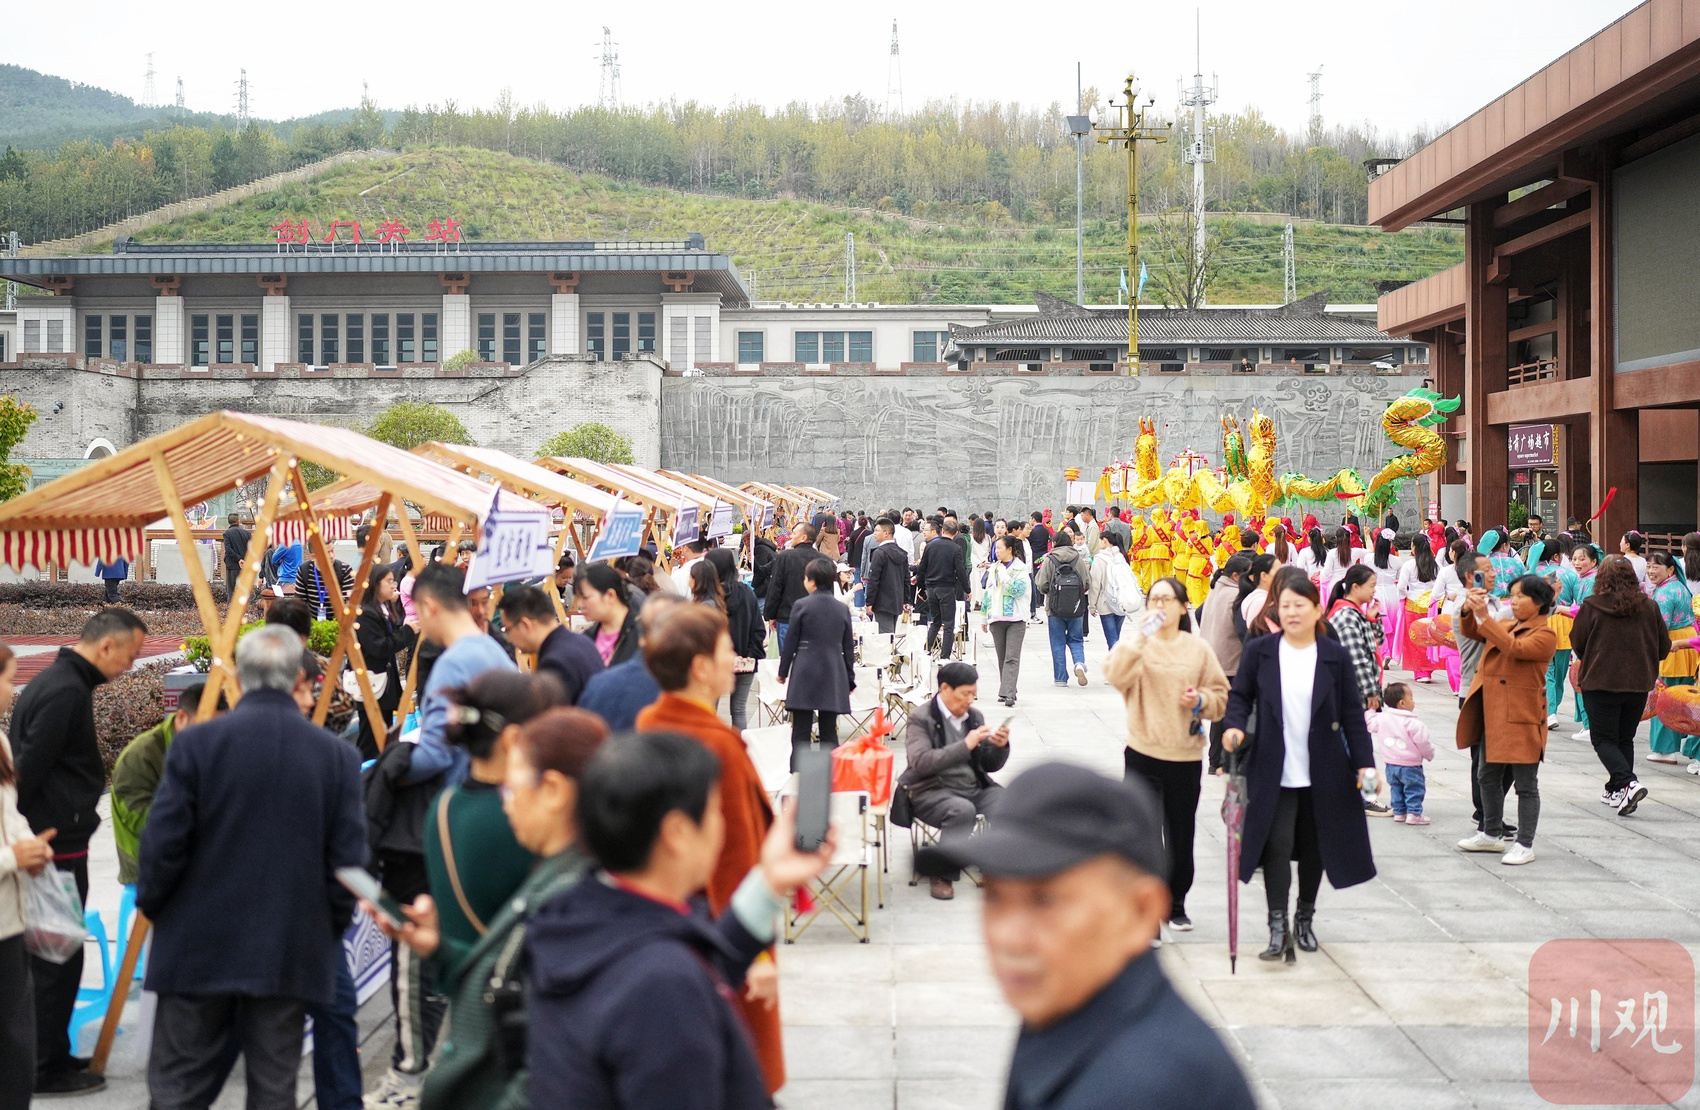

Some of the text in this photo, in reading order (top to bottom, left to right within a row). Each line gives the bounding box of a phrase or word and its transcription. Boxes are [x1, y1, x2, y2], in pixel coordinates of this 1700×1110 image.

[272, 218, 462, 244] 剑门关站
[1543, 480, 1553, 492] 2
